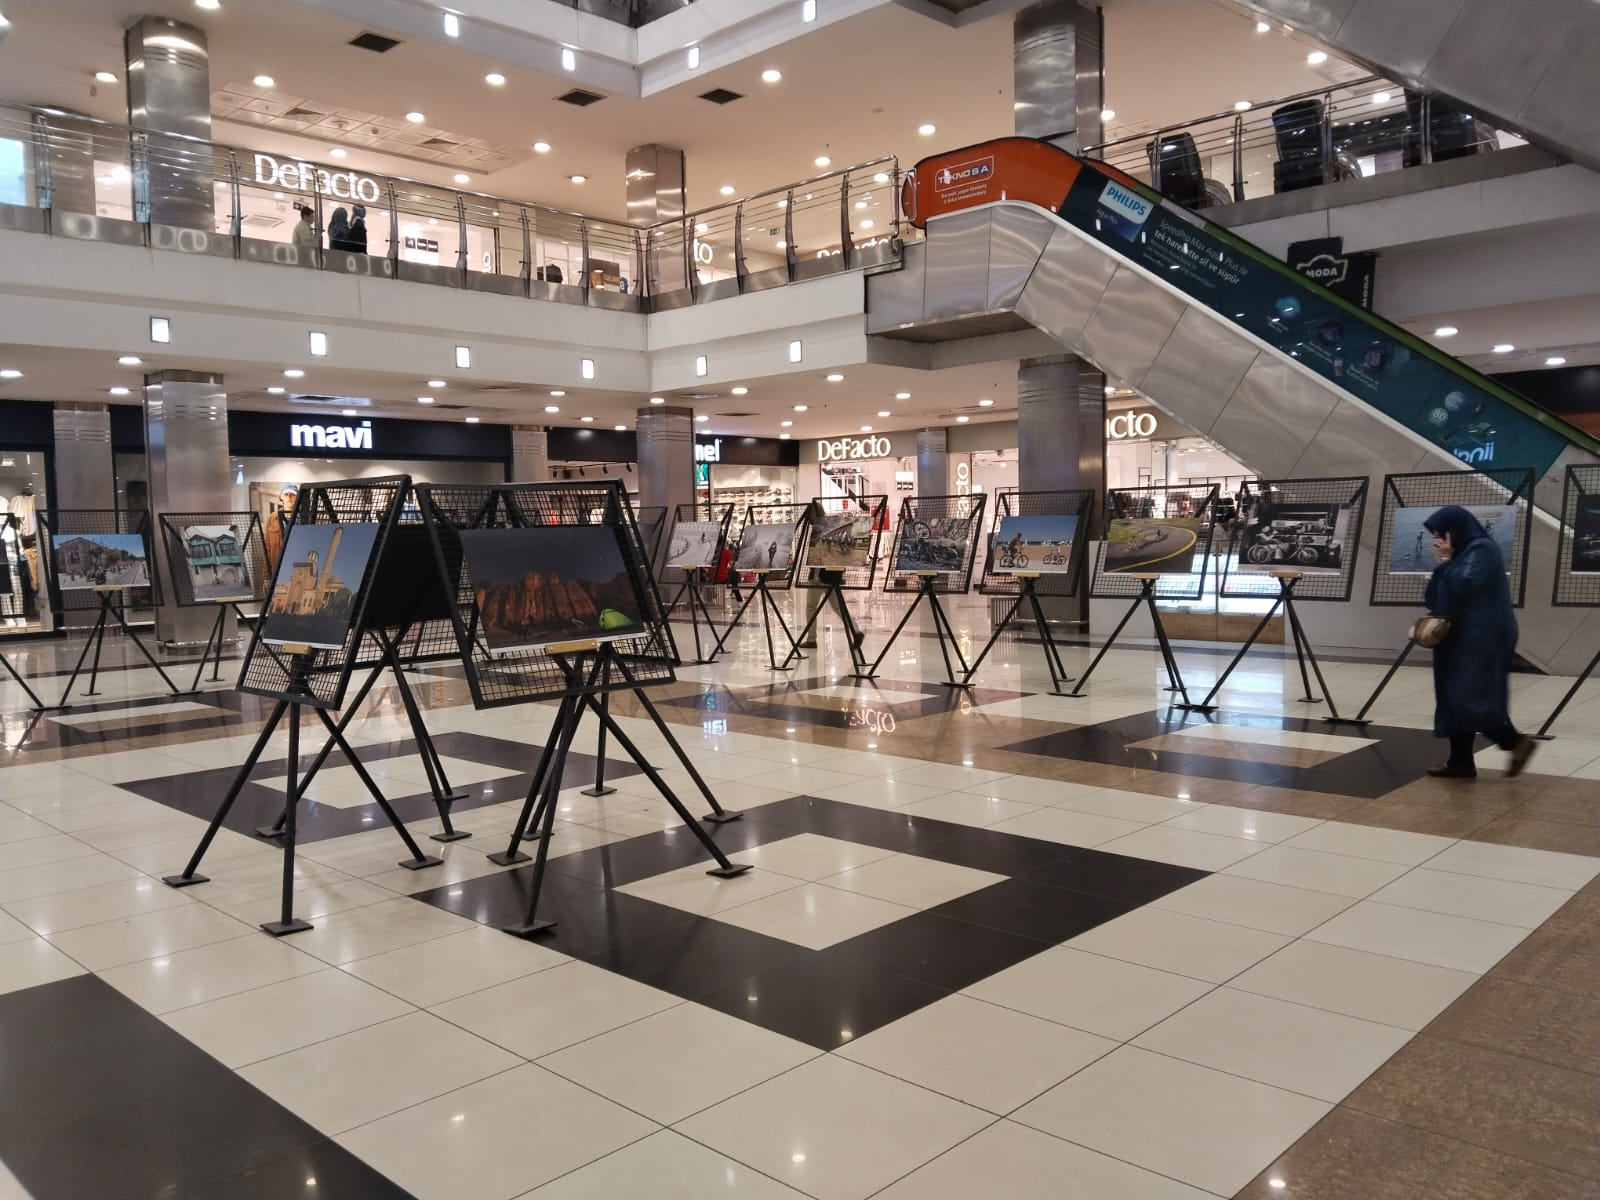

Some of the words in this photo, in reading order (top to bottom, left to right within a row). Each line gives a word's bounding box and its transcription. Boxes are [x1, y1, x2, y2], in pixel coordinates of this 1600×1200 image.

[254, 154, 380, 203] DeFacto
[938, 165, 989, 184] TKNOSA
[1106, 186, 1147, 216] PHILIPS
[1153, 230, 1167, 243] tek
[1199, 254, 1209, 267] sil
[1208, 262, 1218, 272] ve
[1217, 265, 1241, 285] süpür
[1205, 244, 1224, 262] Aqu
[1306, 267, 1338, 278] MODA
[1361, 274, 1369, 308] MODA
[291, 420, 373, 449] mavi
[817, 435, 891, 462] DeFacto
